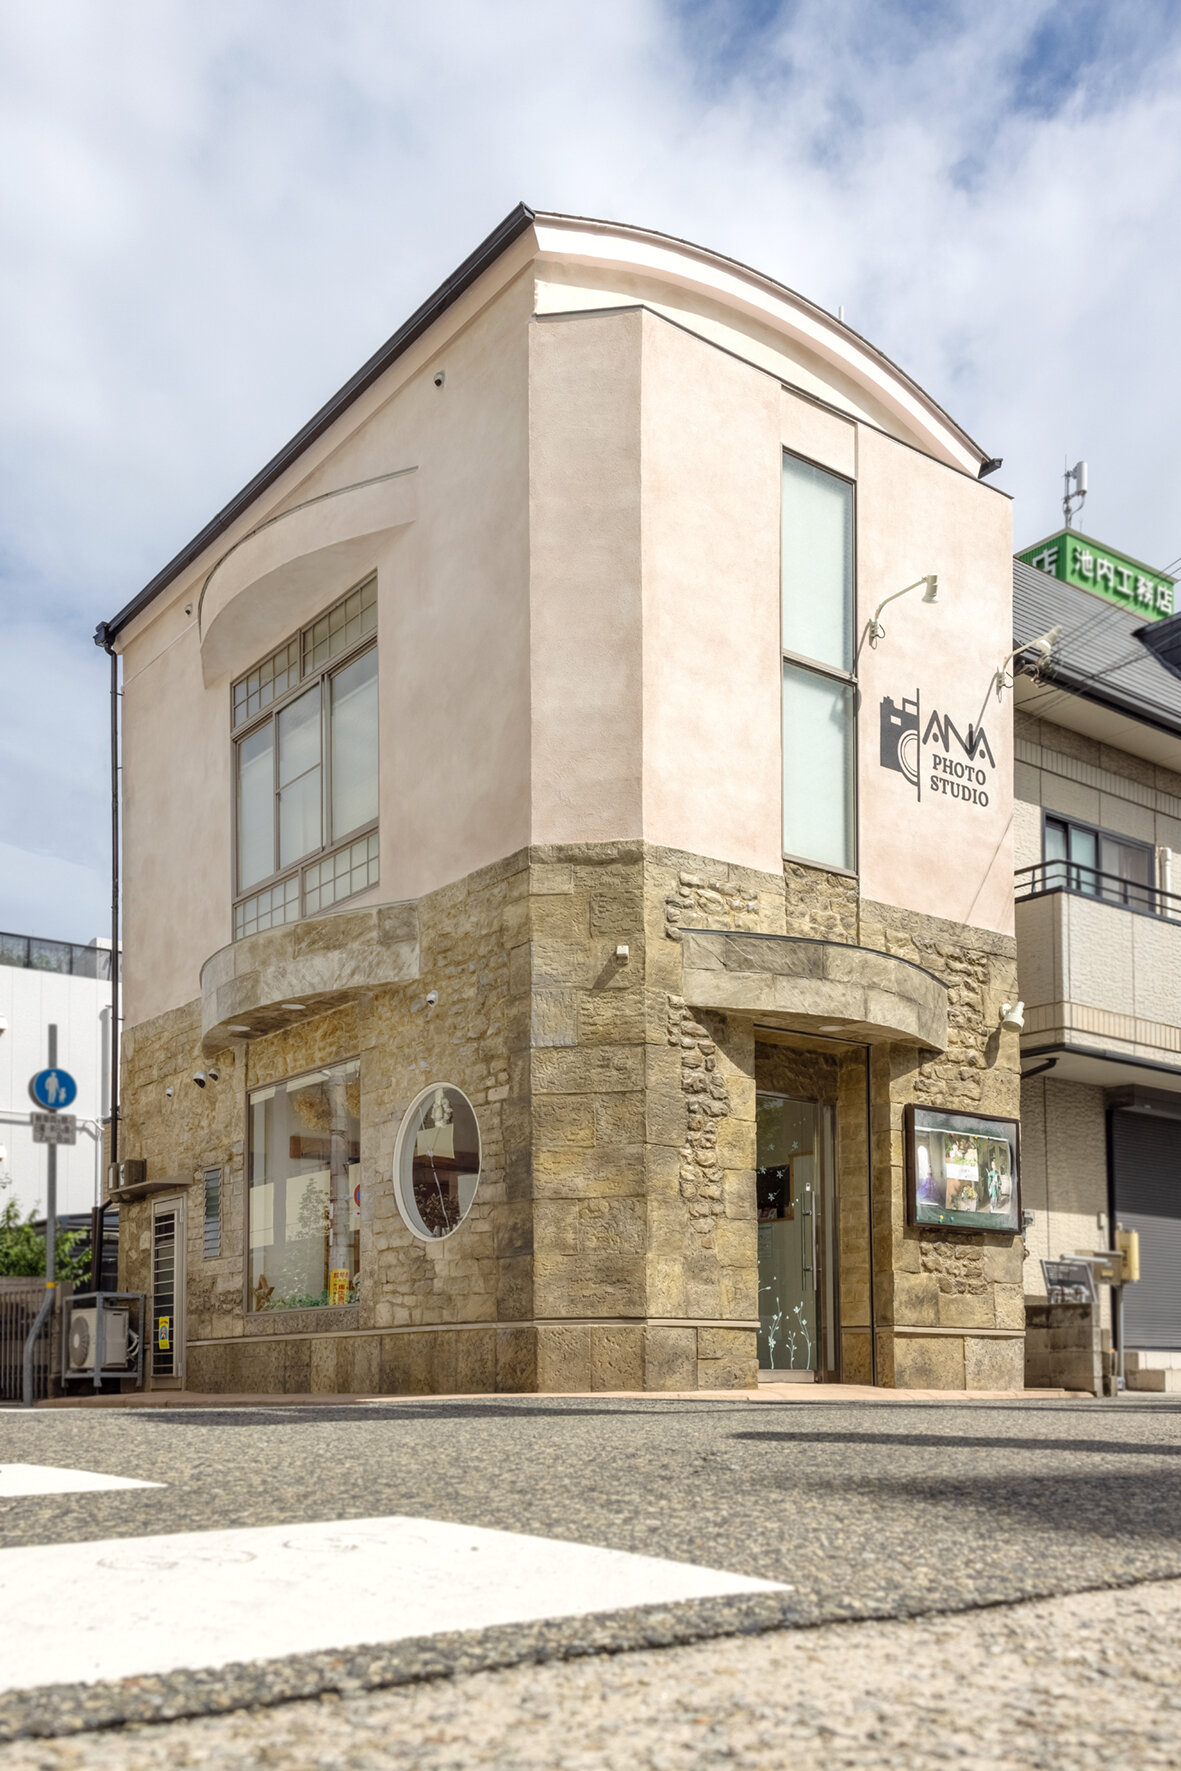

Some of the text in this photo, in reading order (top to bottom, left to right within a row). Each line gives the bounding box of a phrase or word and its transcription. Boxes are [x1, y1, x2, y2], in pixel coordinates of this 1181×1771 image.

[1074, 545, 1173, 615] 池内工務店
[932, 753, 986, 786] PHOTO
[930, 775, 989, 807] STUDIO
